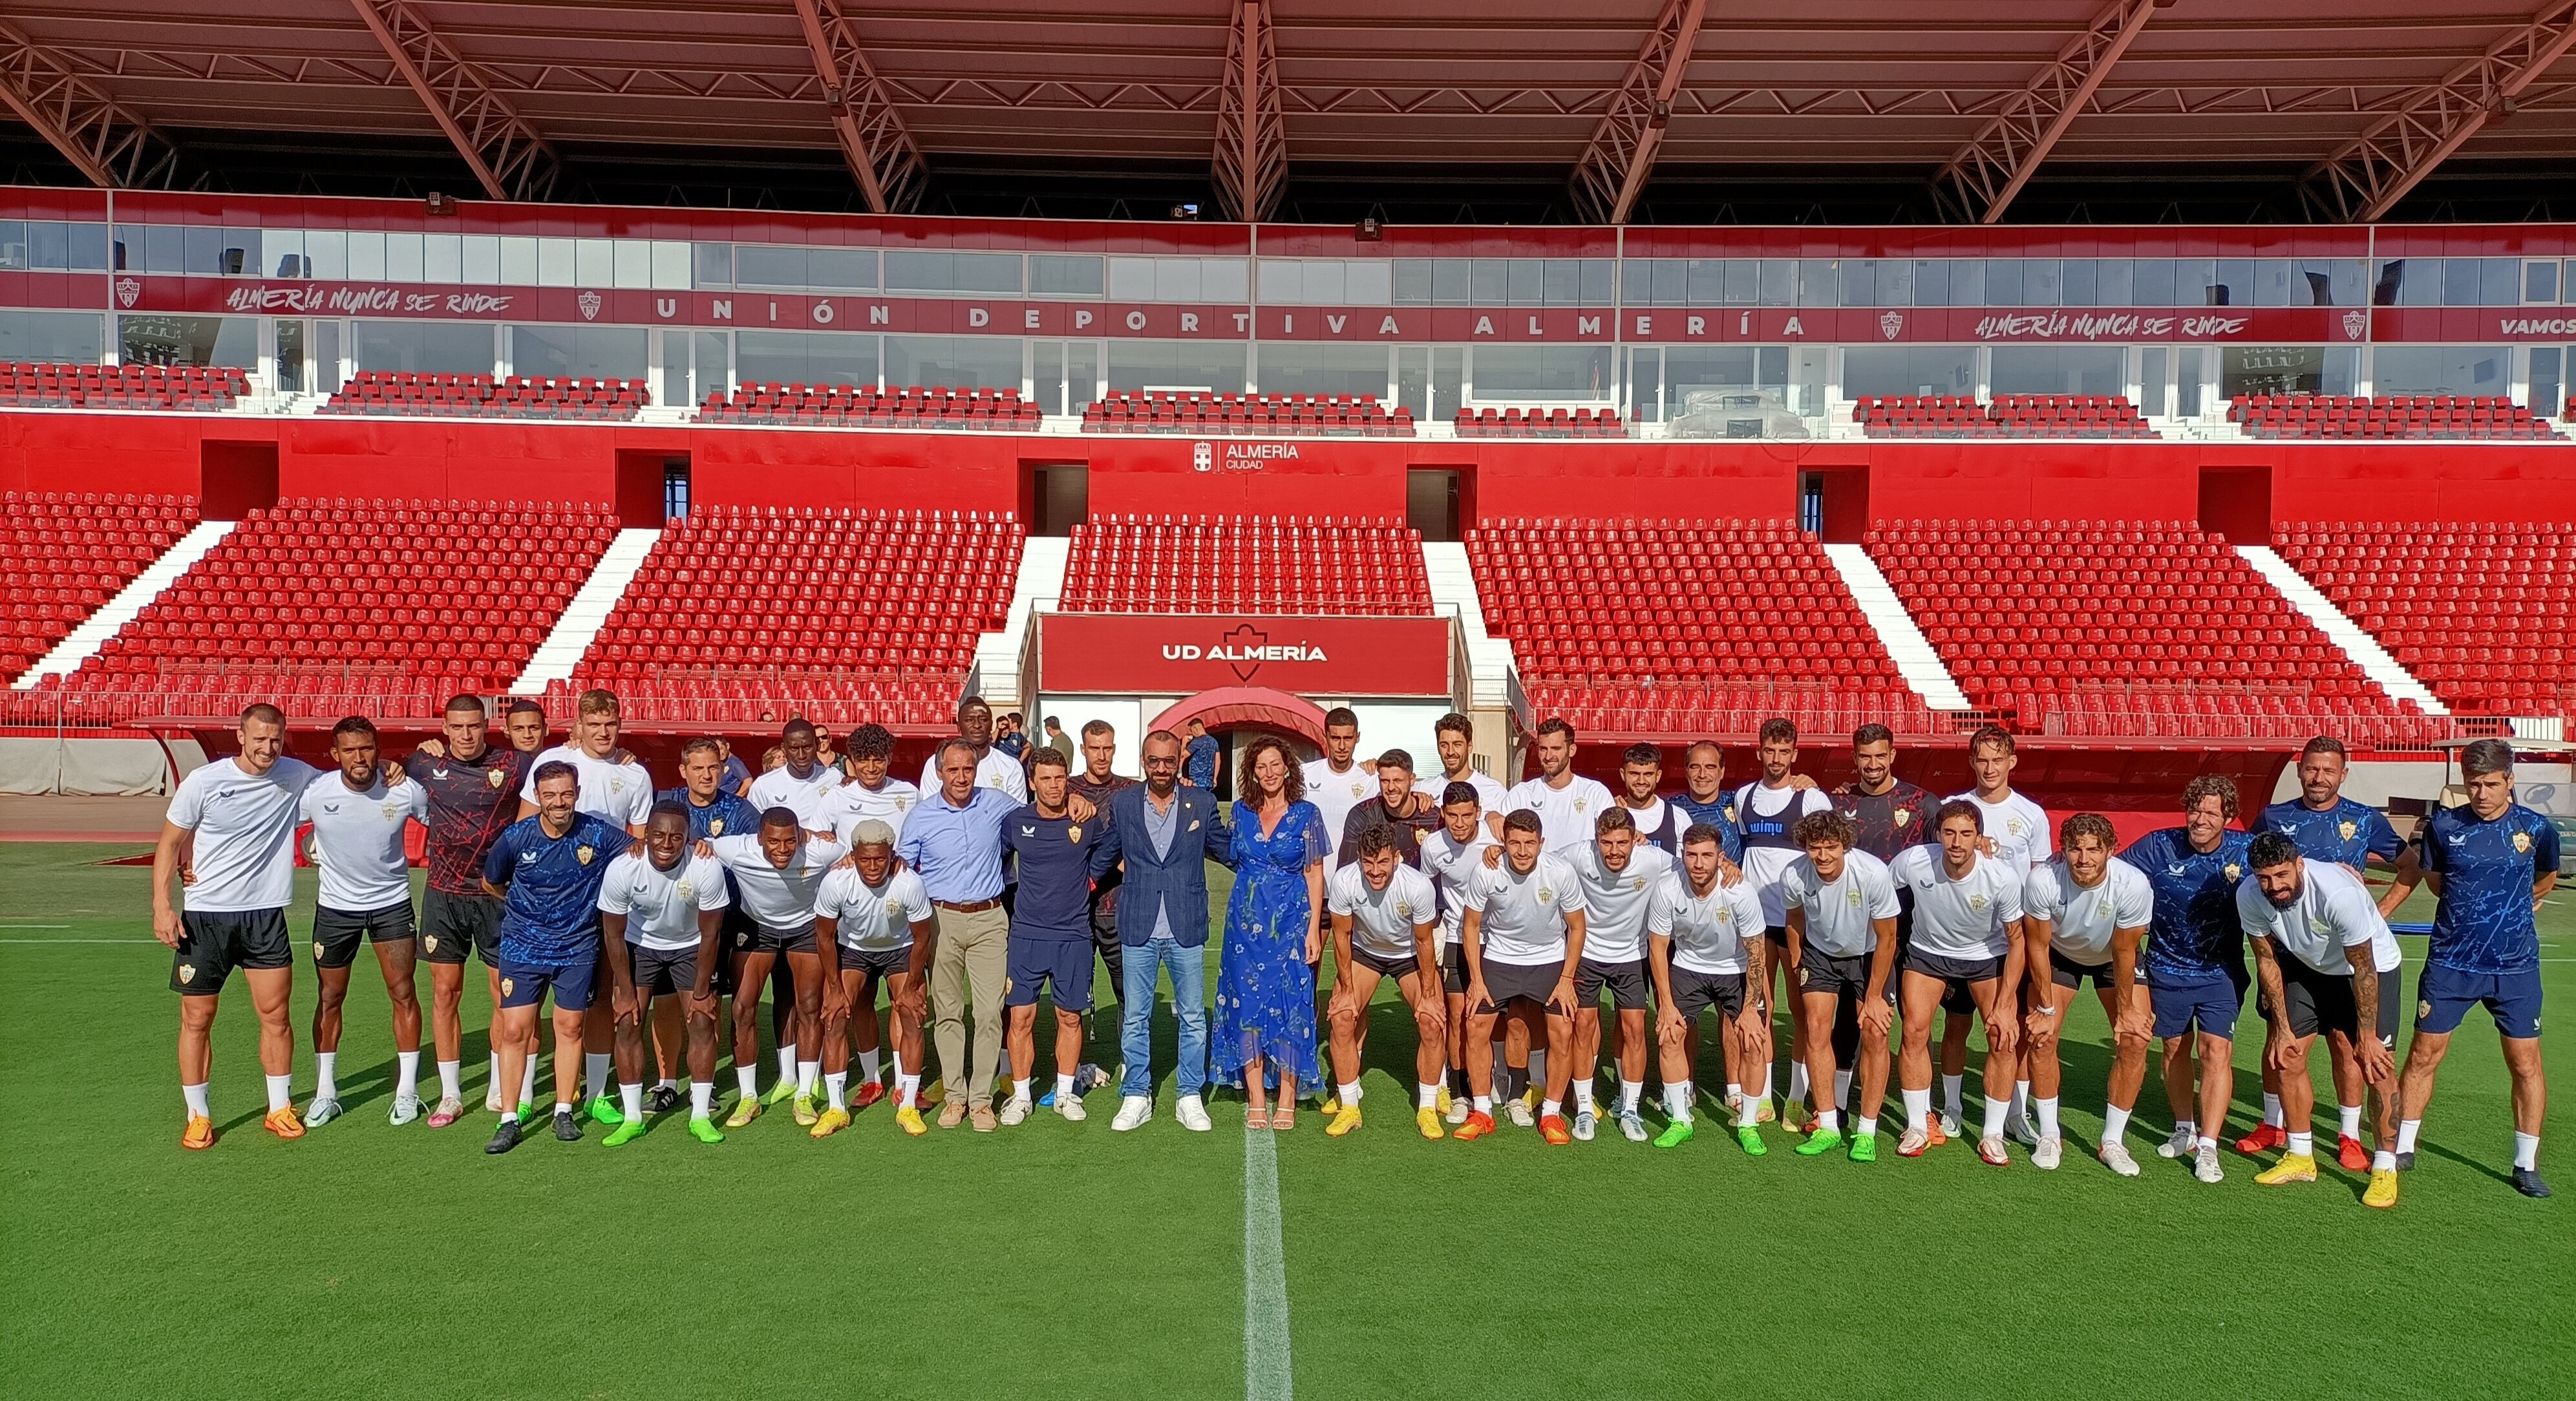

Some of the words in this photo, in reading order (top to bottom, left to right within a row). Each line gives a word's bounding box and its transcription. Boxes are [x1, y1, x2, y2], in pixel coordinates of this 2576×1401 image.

[226, 284, 324, 311] ALMERÍA
[328, 286, 399, 314] NUNCA
[404, 294, 440, 311] SE
[445, 294, 514, 314] RINDE
[657, 299, 888, 325] UNIÓN
[970, 307, 1400, 334] DEPORTIVA
[1473, 311, 1804, 336] ALMERÍA
[1975, 310, 2067, 339] ALMERÍA
[2070, 313, 2139, 340] NUNCA
[2142, 317, 2177, 336] SE
[2182, 316, 2249, 336] RINDE
[2500, 319, 2576, 334] VAMOS
[1226, 442, 1299, 459] ALMERÍA
[1226, 460, 1263, 469] CIUDAD
[1163, 645, 1200, 659] UD
[1206, 641, 1327, 661] ALMERÍA
[1750, 819, 1782, 836] wimu
